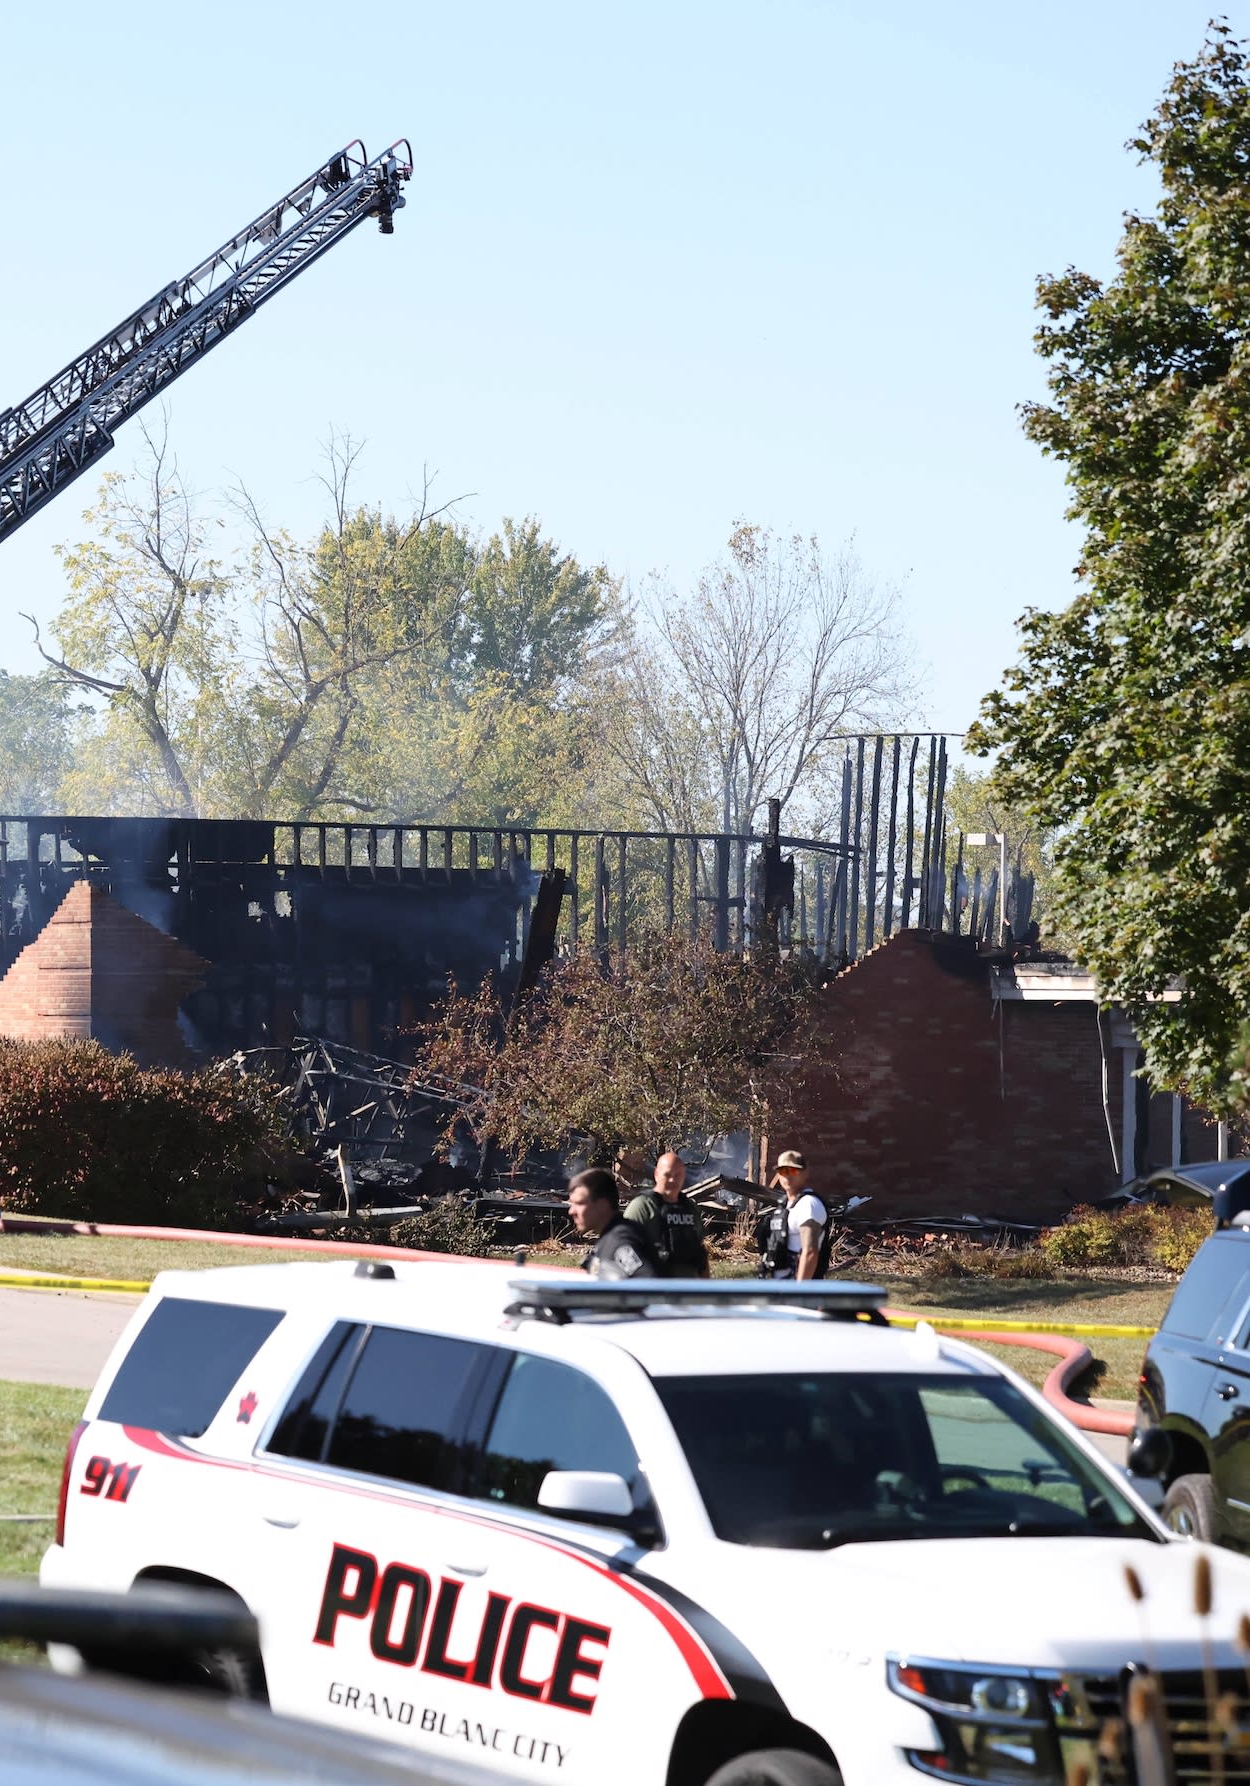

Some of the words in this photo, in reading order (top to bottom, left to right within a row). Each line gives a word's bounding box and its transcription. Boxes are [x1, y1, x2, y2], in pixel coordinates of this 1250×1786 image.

[666, 1213, 695, 1226] POLICE
[79, 1455, 143, 1504] 911
[312, 1541, 613, 1716] POLICE
[327, 1681, 415, 1727] GRAND
[419, 1709, 505, 1751] BLANC
[513, 1734, 571, 1768] CITY
